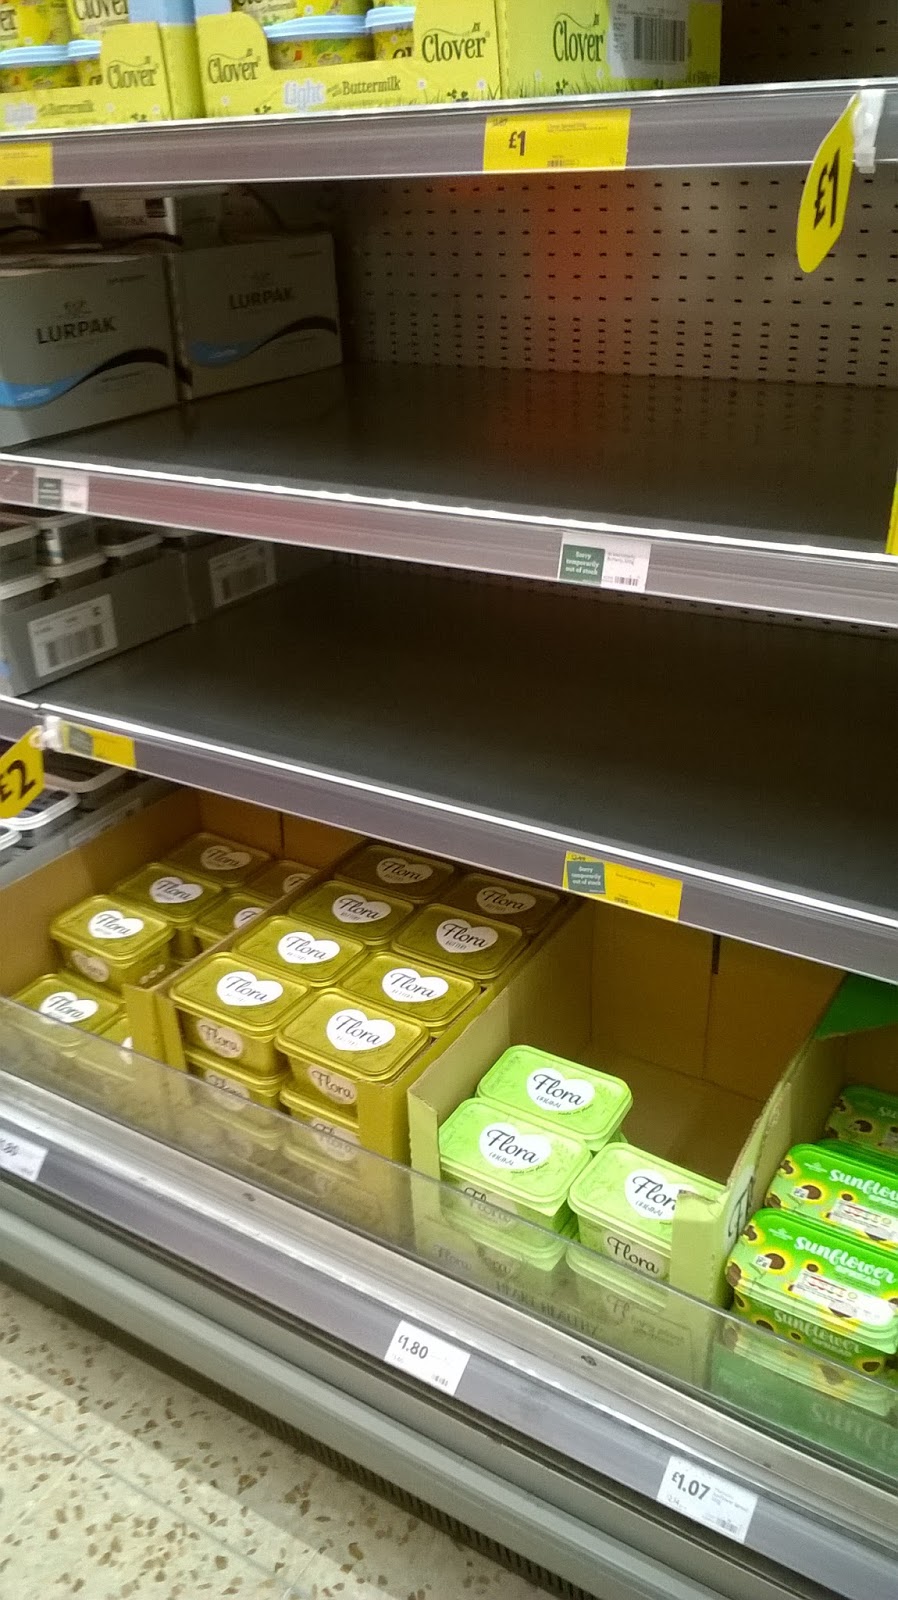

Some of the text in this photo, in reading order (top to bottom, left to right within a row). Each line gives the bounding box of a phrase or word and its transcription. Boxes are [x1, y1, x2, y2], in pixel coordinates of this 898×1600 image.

[421, 34, 486, 63] Clover
[553, 21, 604, 62] Clover
[107, 63, 157, 89] Clover
[207, 58, 259, 84] Clover
[342, 76, 400, 96] Buttermilk
[508, 130, 527, 156] £1
[812, 148, 841, 230] £1
[228, 286, 295, 310] LURPAK
[37, 316, 117, 344] LURPAK
[566, 559, 599, 570] temporarily
[575, 551, 592, 560] Sorry
[382, 860, 422, 881] Flora
[571, 873, 601, 881] temporarily
[157, 881, 192, 900] Flora
[483, 889, 526, 911] Flora
[338, 898, 381, 920] Flora
[96, 913, 131, 934] Flora
[442, 923, 489, 948] Flora
[286, 935, 327, 959] Flora
[227, 976, 268, 1001] Flora
[390, 972, 438, 998] Flora
[48, 994, 85, 1020] Flora
[201, 1023, 240, 1053] Flora
[336, 1014, 383, 1045] Flora
[311, 1070, 355, 1100] Flora
[533, 1073, 585, 1106] Flora
[486, 1129, 540, 1164] Flora
[632, 1175, 677, 1211] Flor
[607, 1236, 660, 1274] Flora
[794, 1236, 897, 1284] Sunflower
[773, 1309, 861, 1353] Sunflower
[671, 1471, 711, 1500] £1.07
